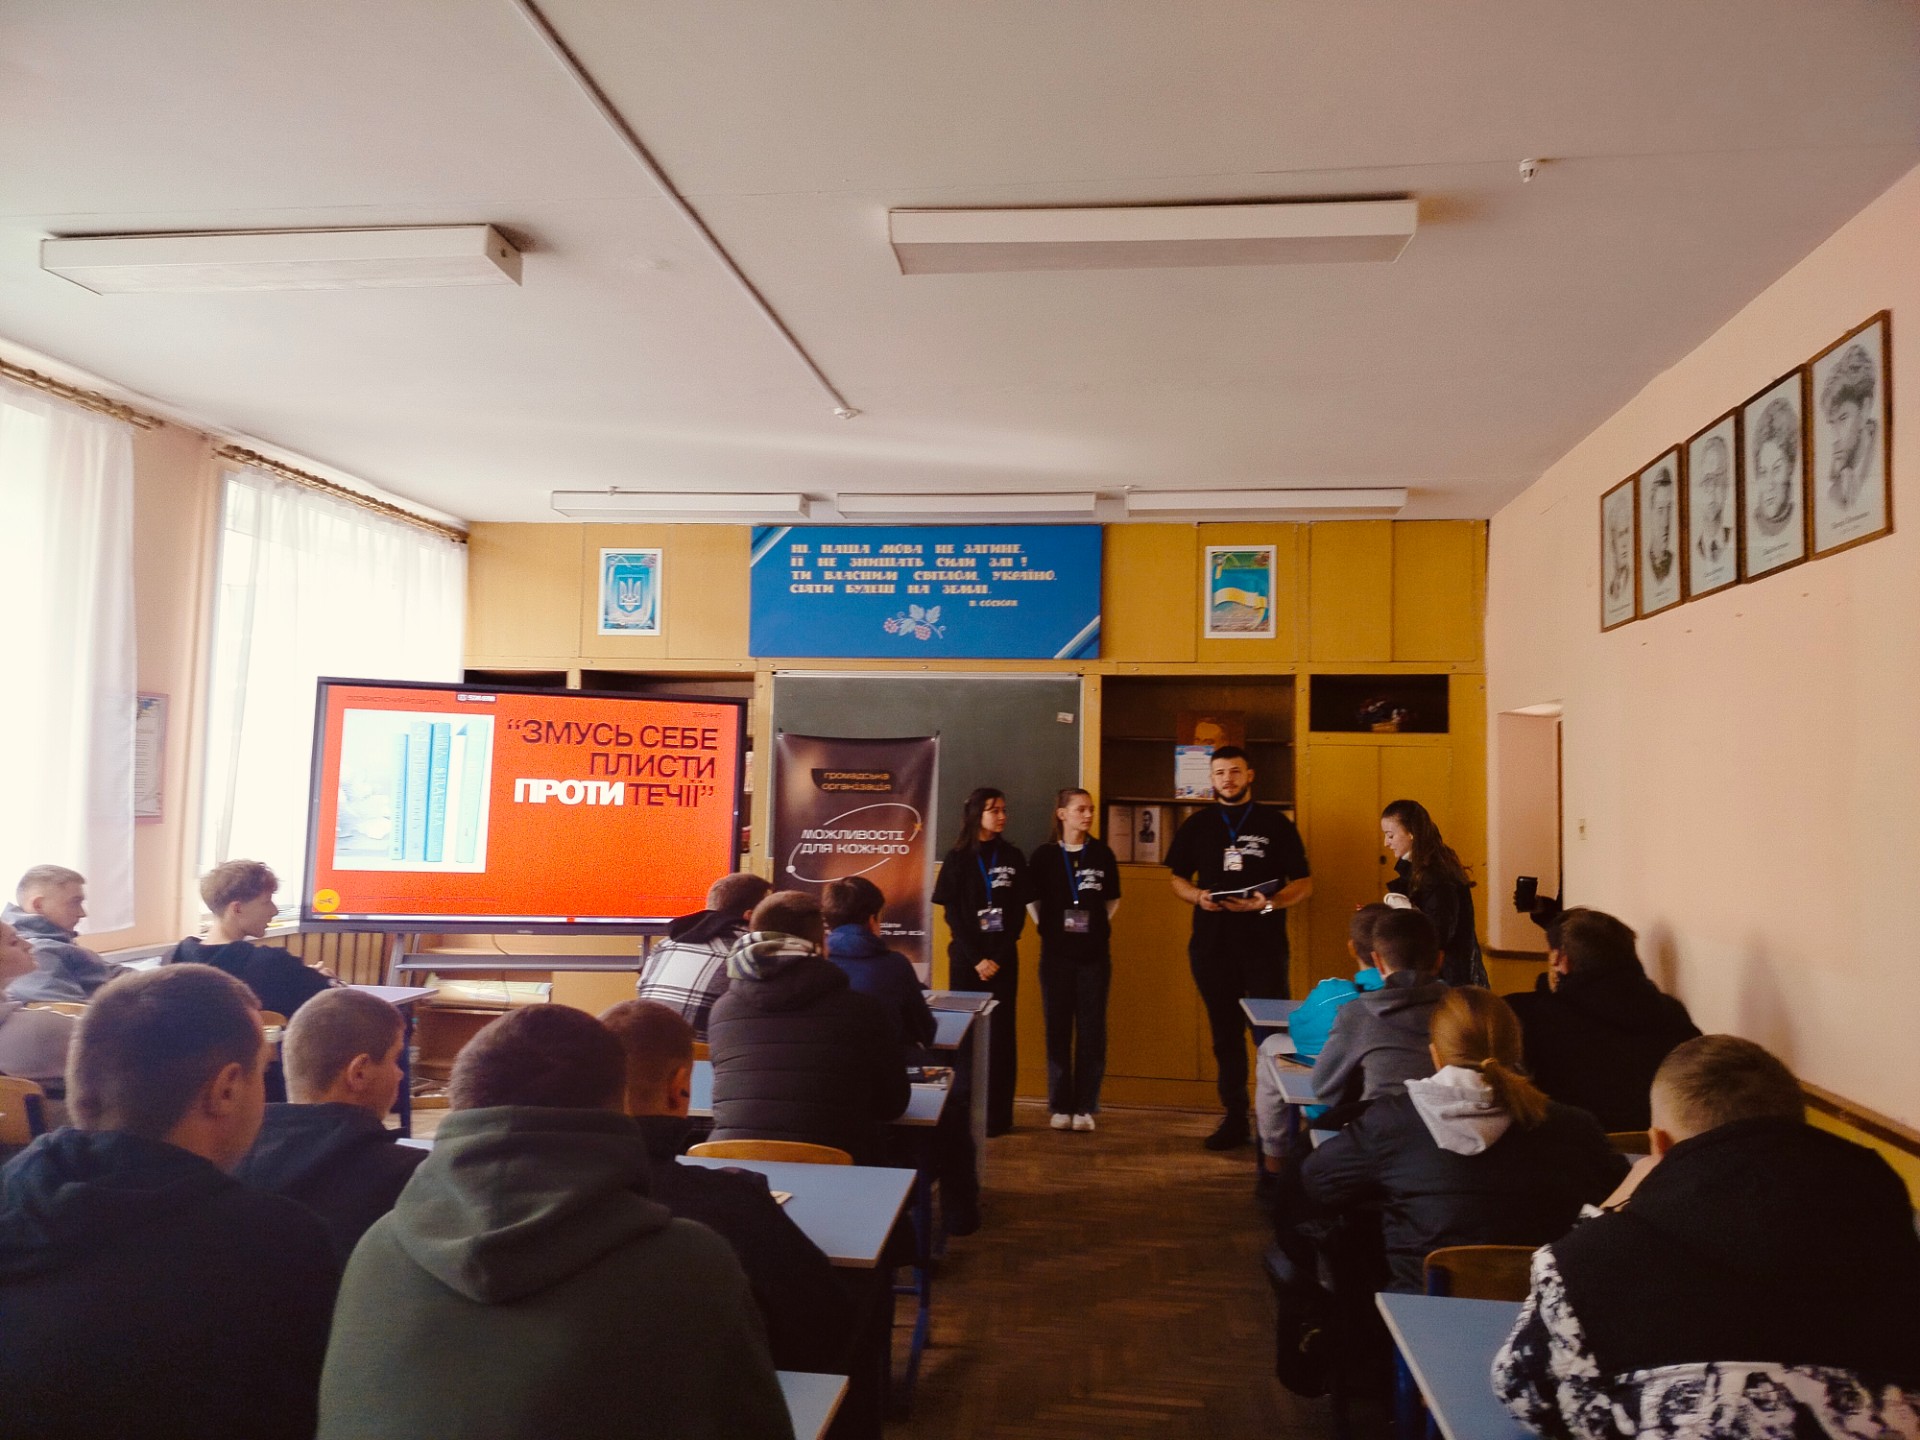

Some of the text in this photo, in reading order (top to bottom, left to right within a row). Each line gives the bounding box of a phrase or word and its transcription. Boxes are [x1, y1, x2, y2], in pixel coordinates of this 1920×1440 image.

[821, 544, 870, 554] НАША
[879, 544, 923, 554] МОВА
[935, 544, 955, 554] НЕ
[817, 558, 837, 567] НЕ
[936, 558, 976, 567] СИЛИ
[791, 571, 812, 580] ТИ
[824, 571, 898, 580] ВЛАСНИМ
[845, 584, 896, 594] БУДЕШ
[907, 584, 930, 594] НА
[639, 725, 719, 751] СЕБЕ
[589, 751, 716, 779] ПЛИСТИ
[513, 777, 625, 806] ПРОТИ
[801, 829, 905, 841] МОЖЛИВОСТІ
[800, 843, 910, 855] ДЛЯ КОЖНОГО
